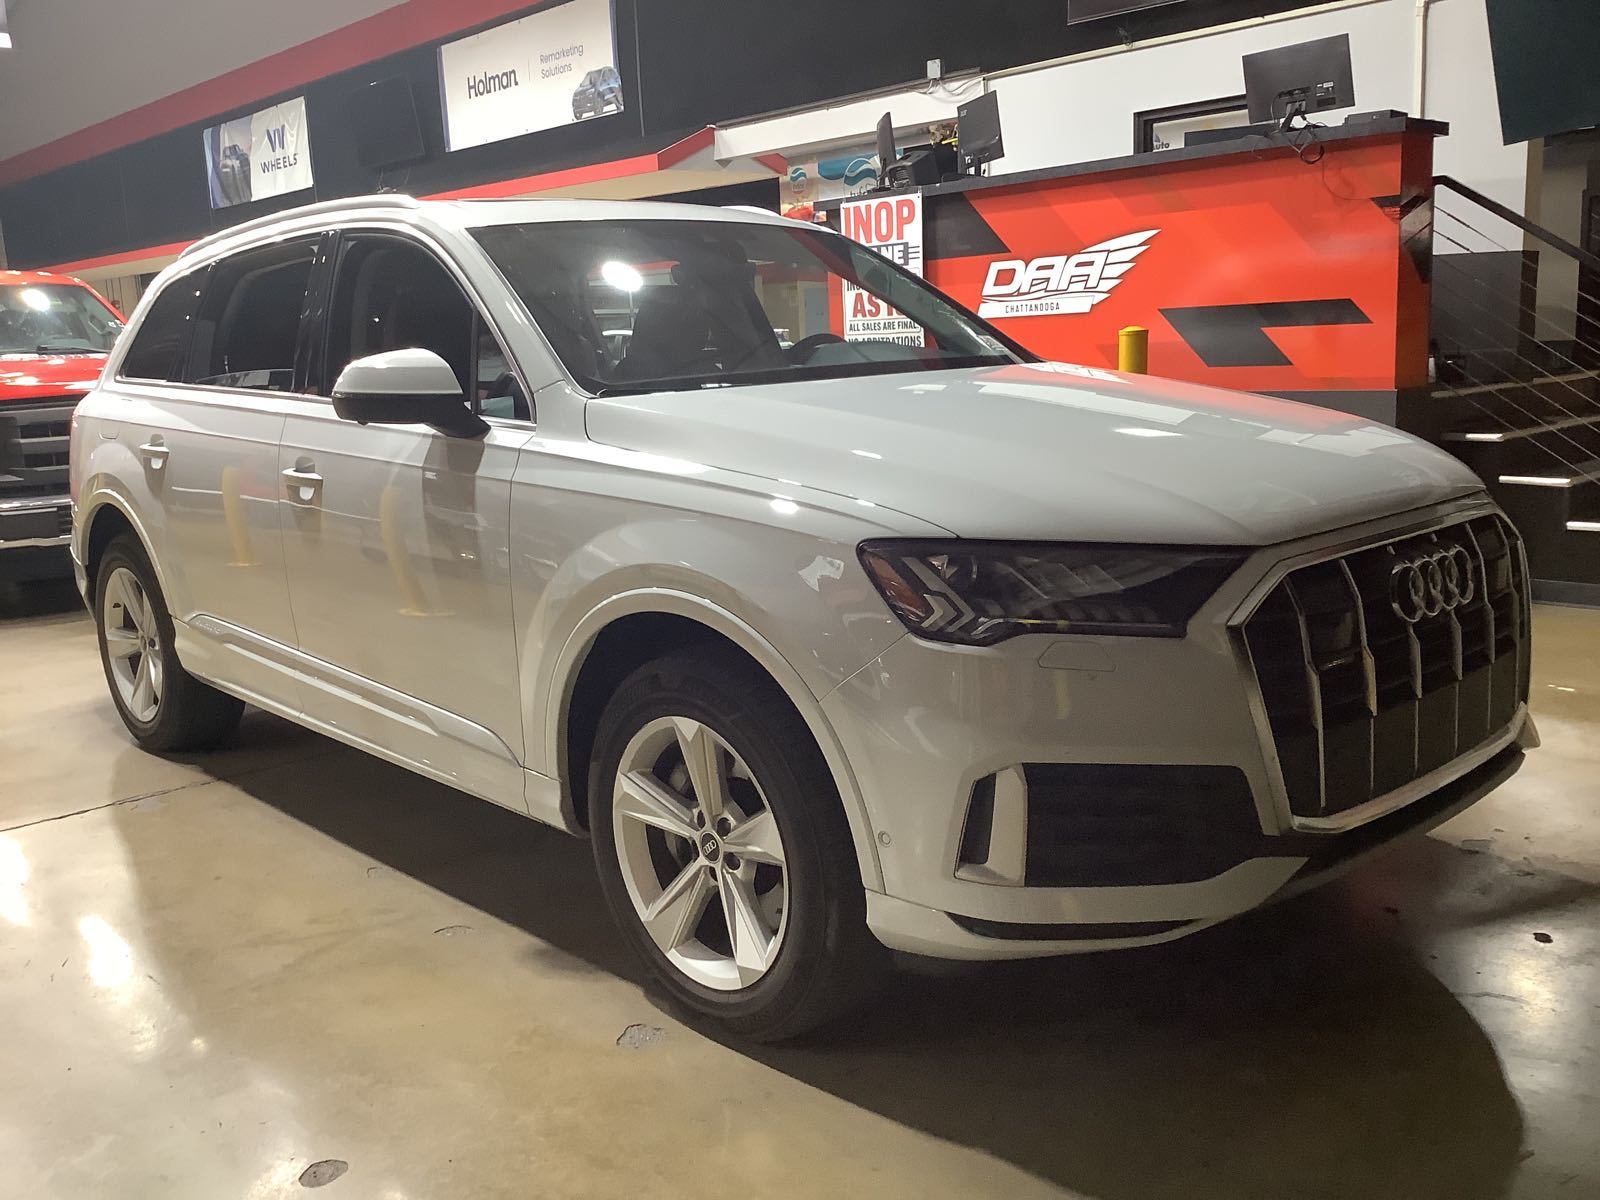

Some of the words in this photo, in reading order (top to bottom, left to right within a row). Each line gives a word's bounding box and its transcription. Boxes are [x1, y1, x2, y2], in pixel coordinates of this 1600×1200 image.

[540, 45, 584, 64] Remarketing
[541, 63, 573, 79] Solutions
[467, 69, 519, 99] Holman
[1153, 142, 1170, 150] uto
[260, 153, 298, 174] WHEELS
[844, 199, 916, 243] INOP
[982, 251, 1110, 296] DAA
[853, 292, 881, 317] AS
[1005, 302, 1060, 314] CHATTANOOGA
[849, 323, 860, 332] ALL
[862, 322, 881, 331] SALES
[883, 321, 896, 331] ARE
